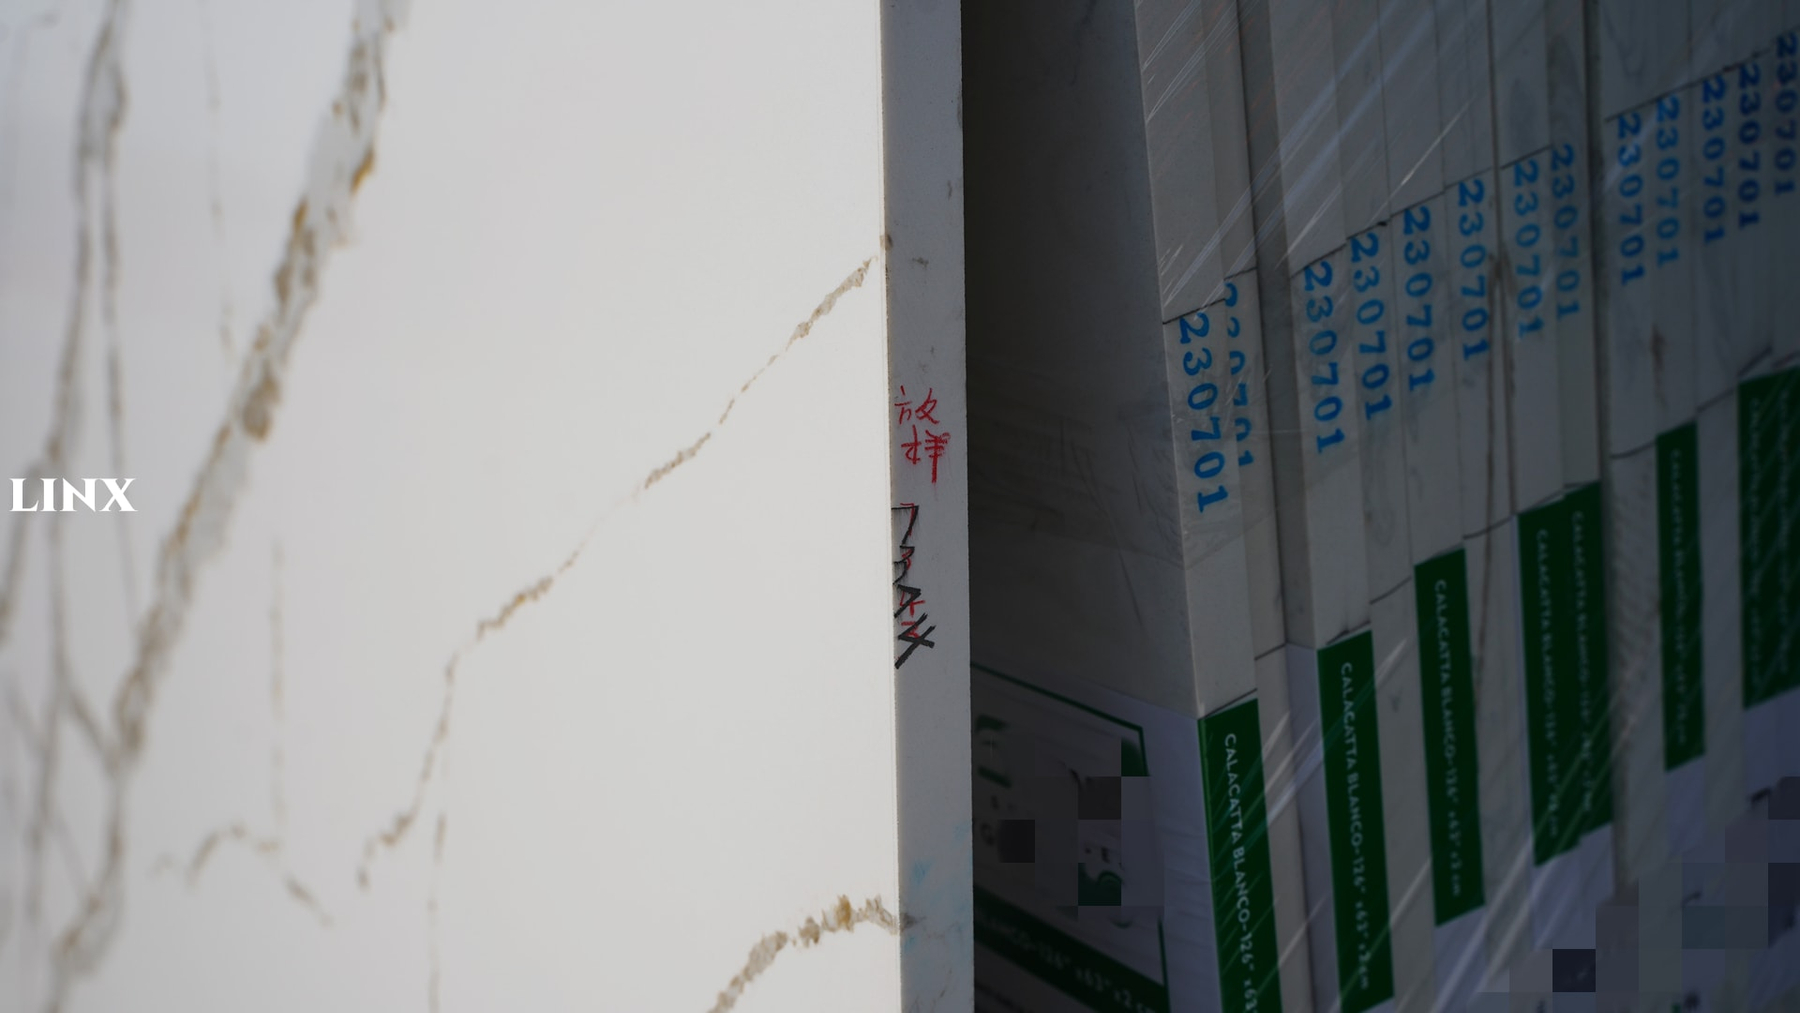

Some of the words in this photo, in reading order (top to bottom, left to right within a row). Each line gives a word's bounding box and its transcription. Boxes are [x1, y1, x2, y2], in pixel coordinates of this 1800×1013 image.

[1618, 112, 1646, 286] 230701
[1655, 95, 1680, 268] 230701
[1701, 74, 1727, 245] 230701
[1737, 62, 1762, 230] 230701
[1773, 32, 1798, 196] 230701
[1403, 206, 1435, 391] 230701
[1458, 179, 1490, 361] 230701
[1513, 160, 1545, 338] 230701
[1551, 143, 1581, 320] 230701
[1179, 312, 1229, 513] 230701
[1303, 261, 1345, 453] 230701
[1350, 232, 1393, 421] 230701
[1340, 661, 1359, 771] CALACATTA
[1434, 578, 1453, 685] CALACATTA
[1224, 732, 1243, 844] CALACATTA
